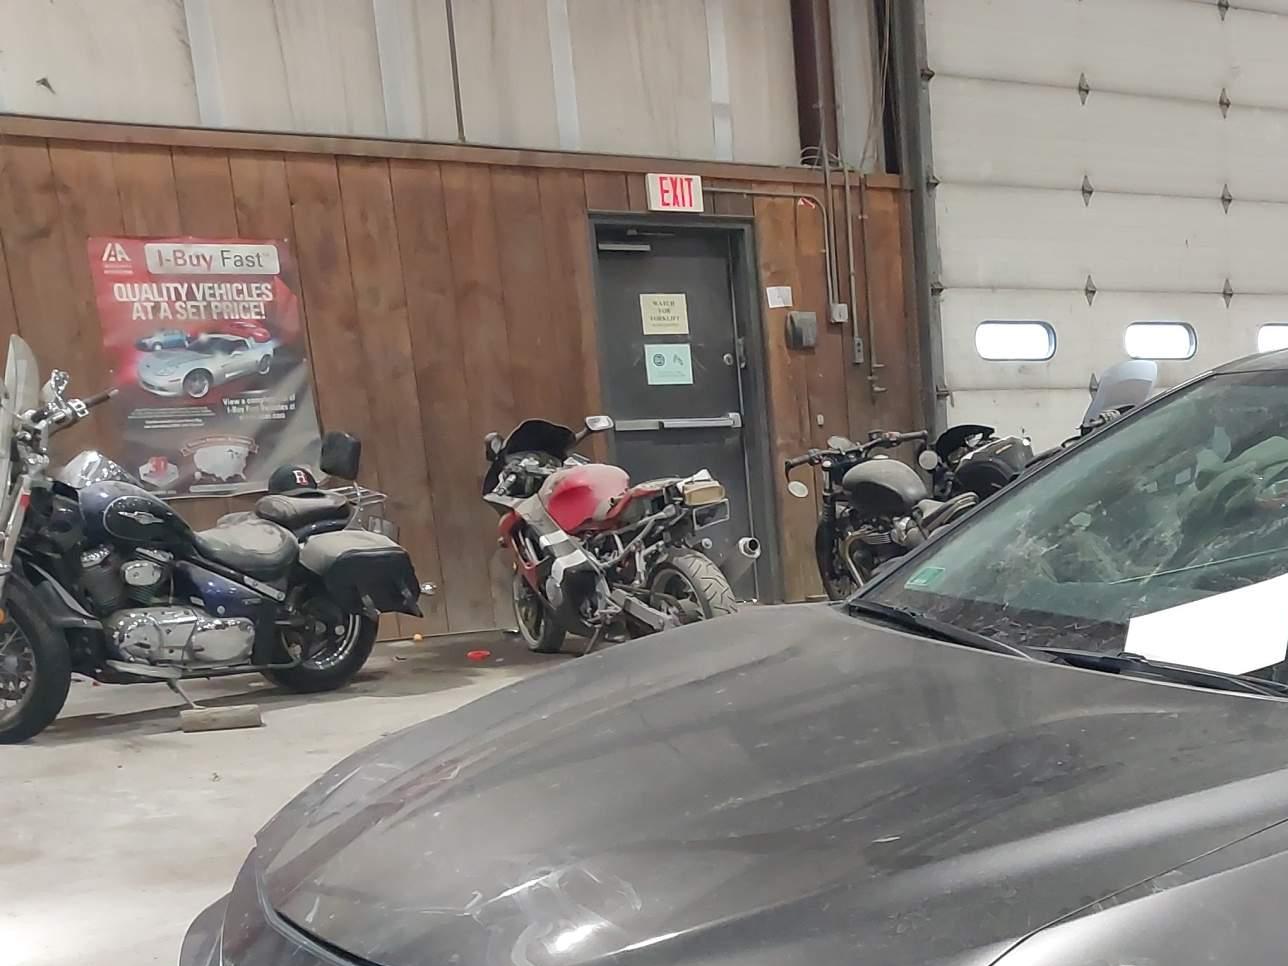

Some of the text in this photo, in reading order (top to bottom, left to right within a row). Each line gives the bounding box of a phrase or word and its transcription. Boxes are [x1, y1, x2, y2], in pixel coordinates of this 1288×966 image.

[659, 176, 693, 207] EXIT
[156, 249, 214, 271] I-Buy
[113, 282, 273, 302] QUALITY VEHICLES
[132, 302, 267, 320] AT A SET PRICE!
